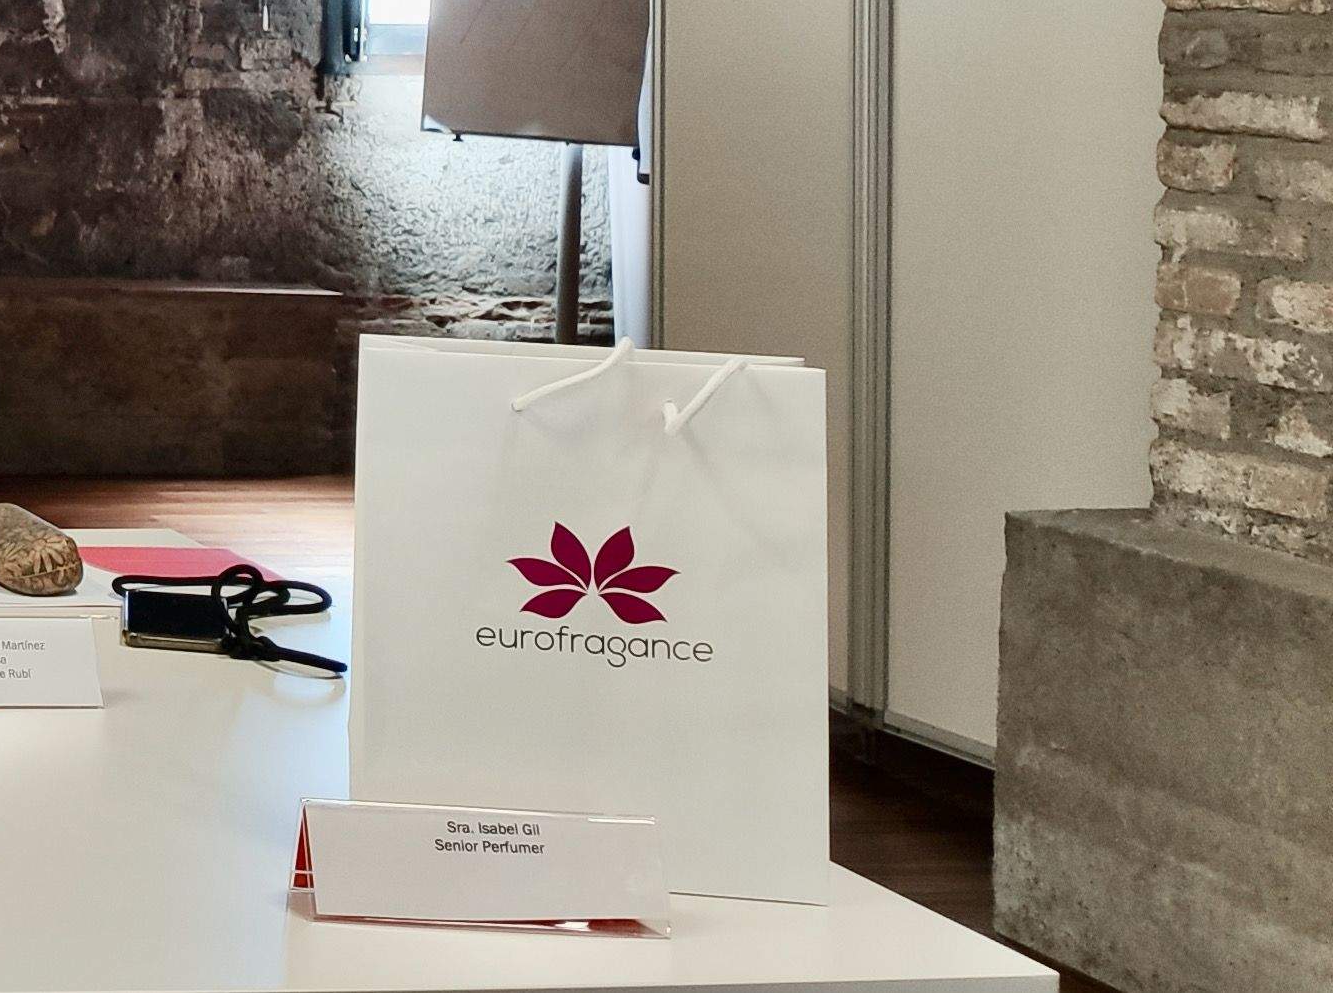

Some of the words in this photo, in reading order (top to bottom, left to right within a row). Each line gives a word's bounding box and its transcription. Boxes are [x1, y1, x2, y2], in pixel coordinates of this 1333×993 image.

[1, 640, 46, 651] Martínez
[476, 625, 714, 667] eurofragance
[446, 821, 474, 834] Sra.
[478, 821, 519, 835] Isabel
[522, 823, 541, 836] Gil
[434, 839, 478, 853] Senior
[482, 840, 545, 855] Perfumer
